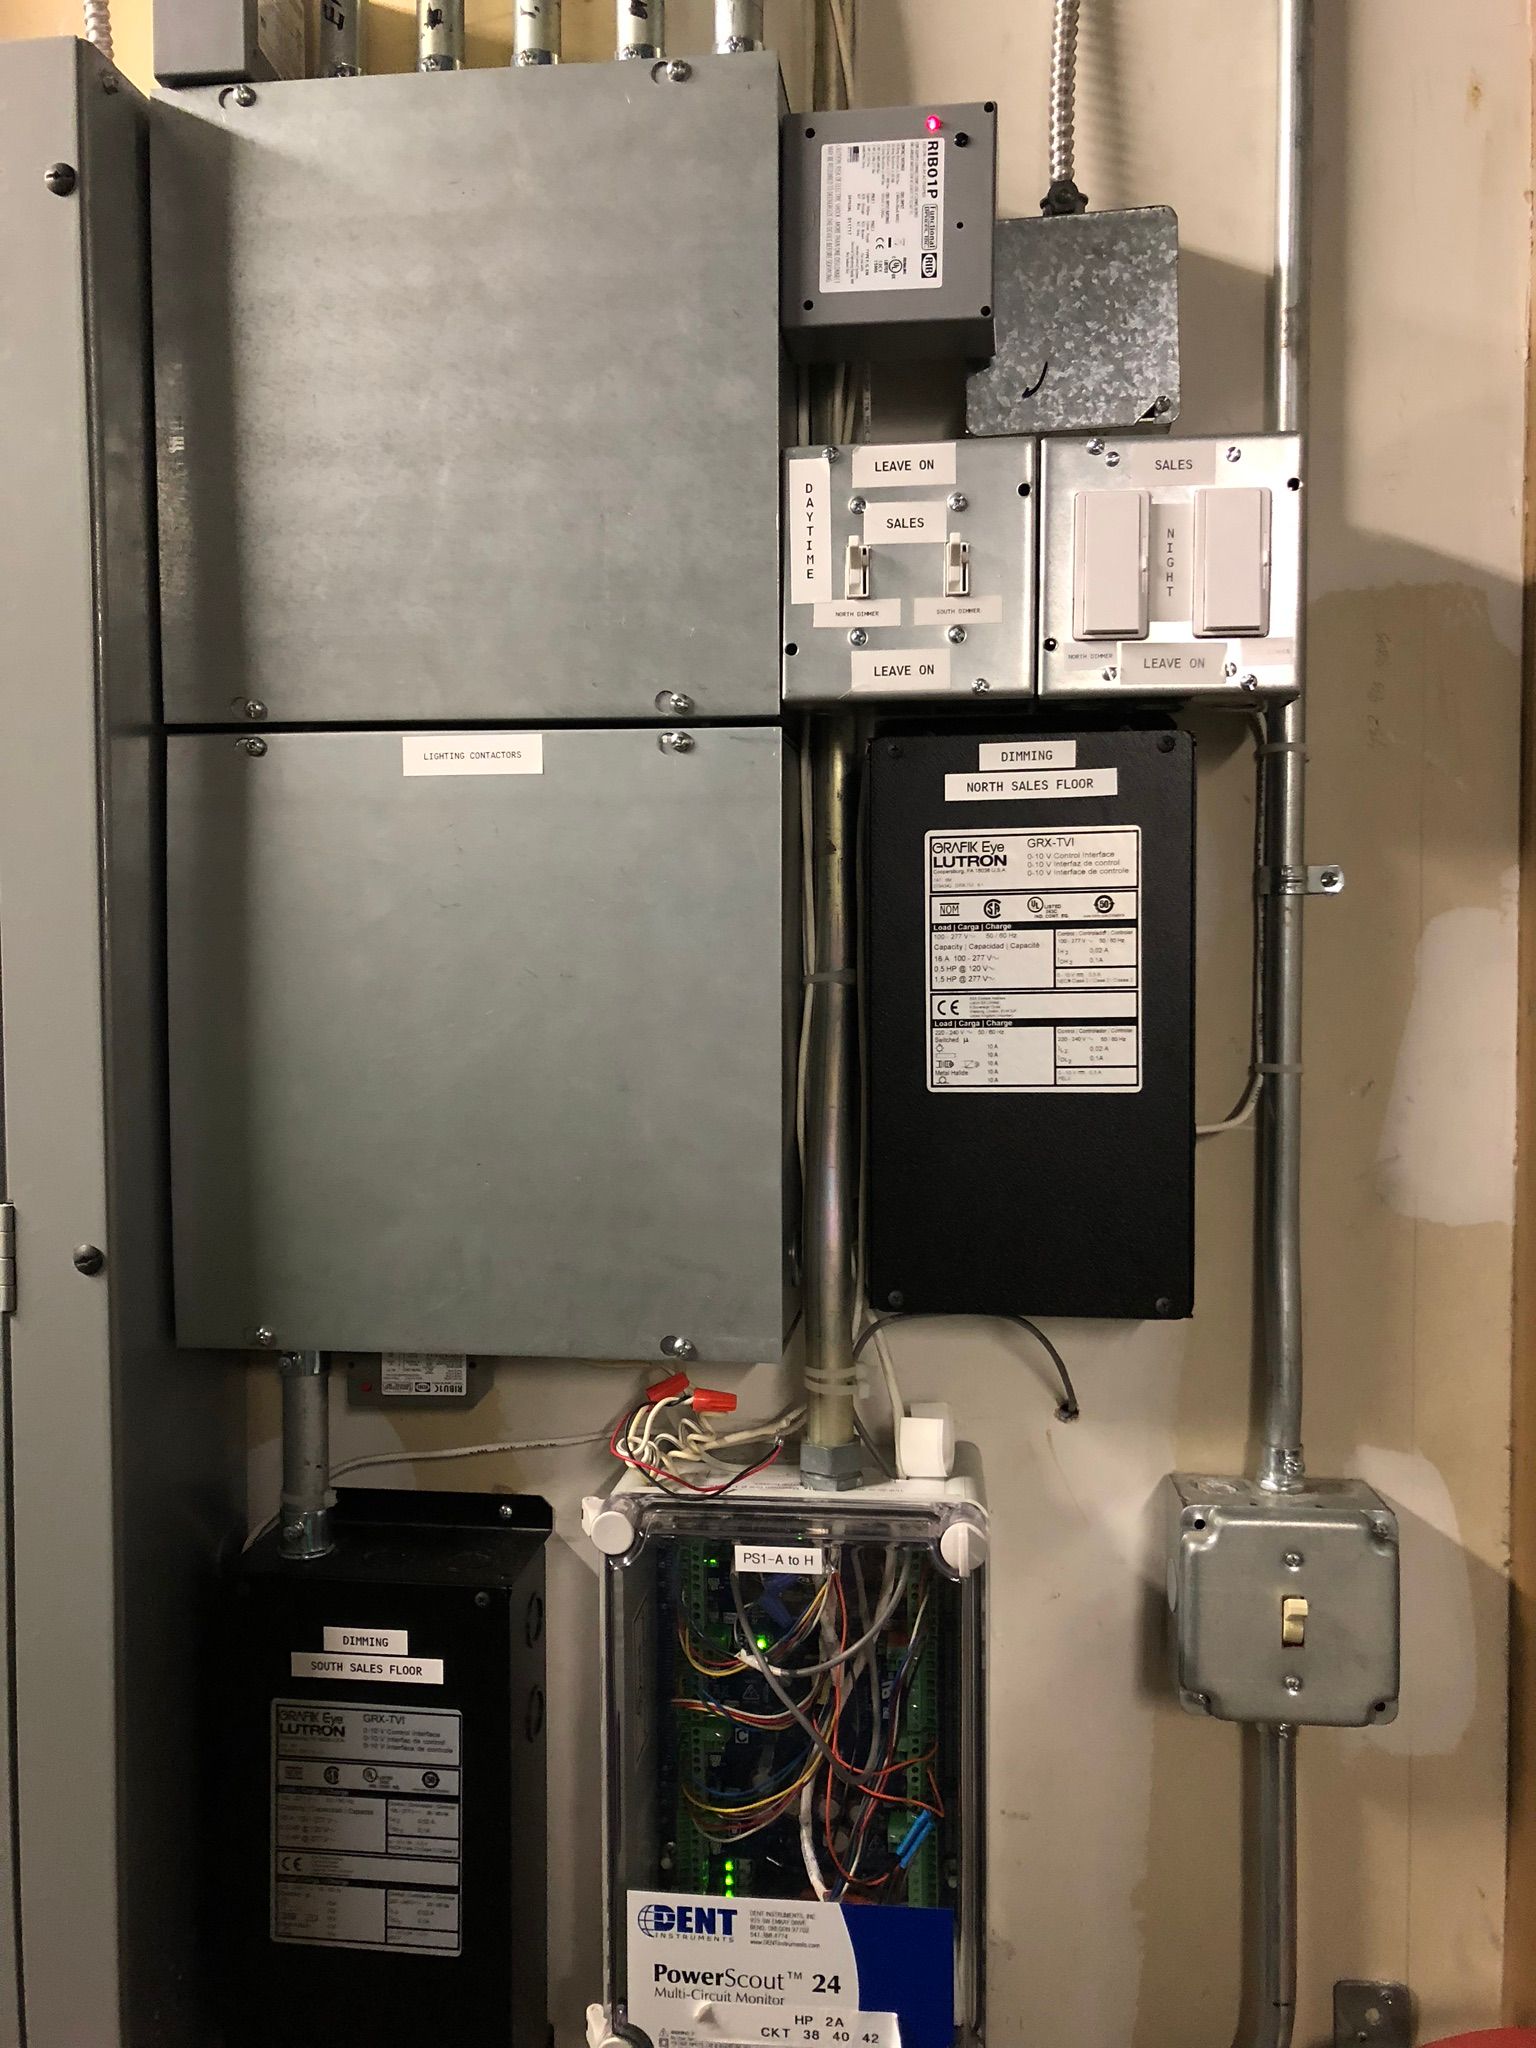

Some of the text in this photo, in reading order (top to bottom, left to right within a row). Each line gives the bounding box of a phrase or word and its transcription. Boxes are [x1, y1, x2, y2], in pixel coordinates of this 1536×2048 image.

[927, 141, 939, 199] RIB01P
[925, 256, 933, 274] RIB
[874, 460, 934, 472] LEAVE ON
[1155, 459, 1193, 470] SALES
[886, 518, 925, 529] SALES
[805, 483, 814, 579] DAYTIME
[1166, 528, 1175, 597] NIGHT
[1143, 658, 1205, 669] LEAVE ON
[874, 665, 934, 677] LEAVE ON
[424, 751, 522, 760] LIGHTING CONTACTORS
[1001, 750, 1053, 762] DIMMING
[966, 778, 1094, 792] NORTH SALES FLOOR
[932, 841, 1004, 855] GRAFIK Eye
[1027, 838, 1074, 848] GRX-TVI
[933, 855, 1007, 868] LUTRON
[958, 924, 979, 932] Carga
[986, 923, 1012, 931] Charge
[958, 1020, 980, 1028] Carga
[743, 1552, 814, 1566] PS1-A to H
[342, 1636, 389, 1648] DIMMING
[311, 1661, 422, 1676] SOUTH SALES FLOOR
[280, 1723, 346, 1737] LUTRON
[654, 1904, 738, 1936] DENT
[654, 1933, 734, 1943] INSTRUMENTS
[812, 1974, 841, 1994] 24
[654, 1986, 784, 2005] Multi-Circuit Monitor
[795, 2015, 844, 2027] HP 2A
[761, 2027, 879, 2043] CKT 38 40 42
